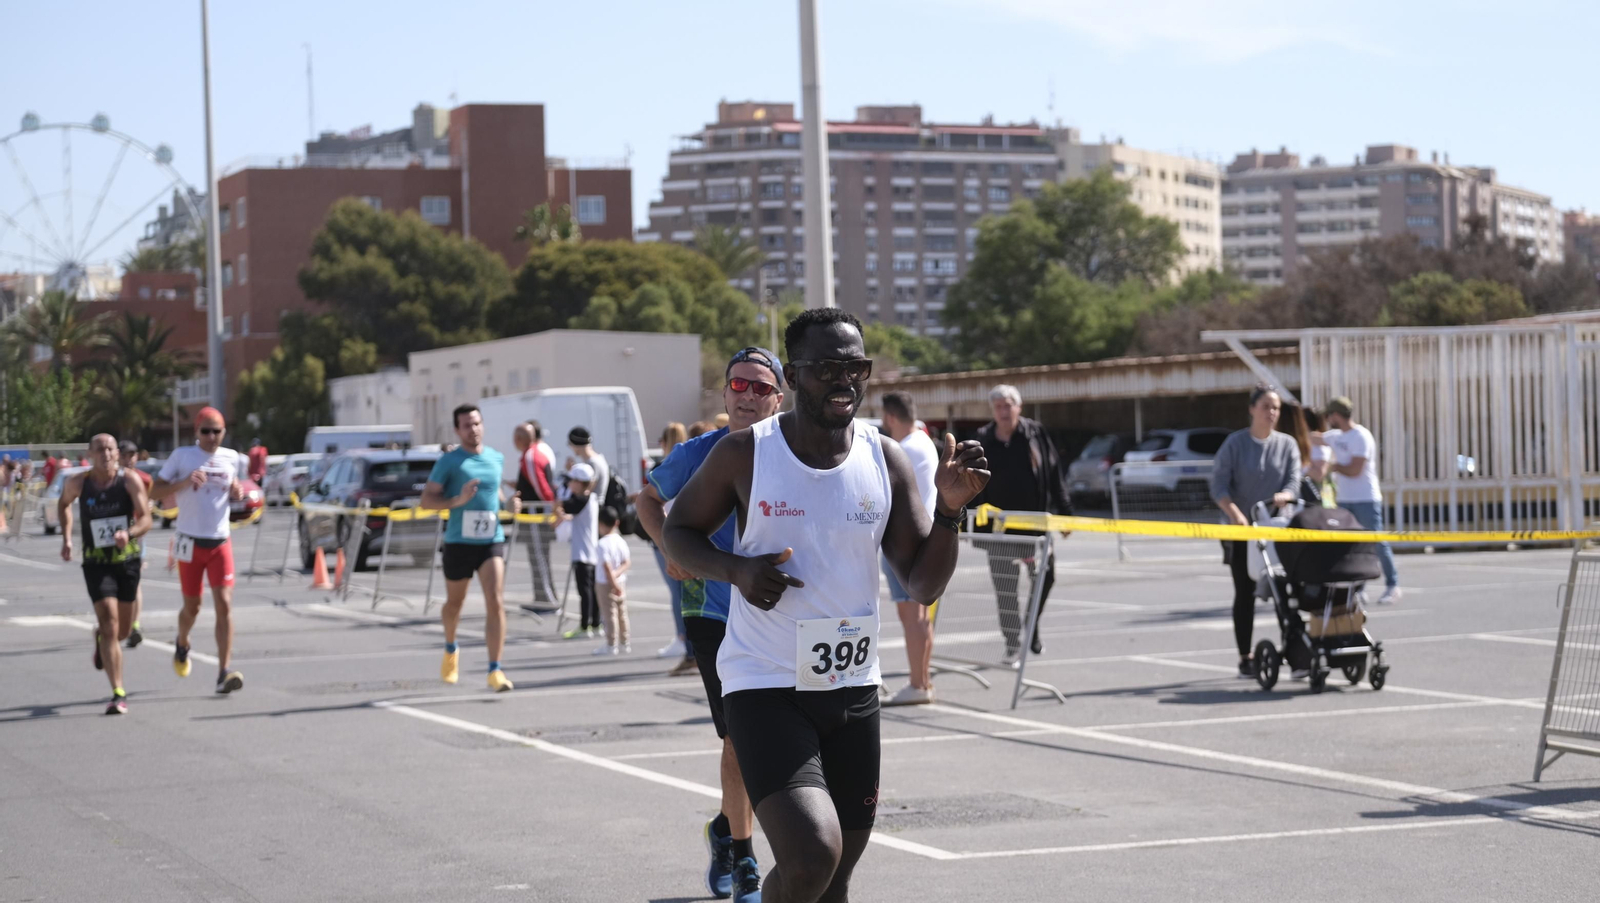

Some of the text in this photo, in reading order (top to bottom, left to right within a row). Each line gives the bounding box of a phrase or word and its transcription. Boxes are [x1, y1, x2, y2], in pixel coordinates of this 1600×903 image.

[774, 500, 787, 508] La
[473, 519, 489, 531] 73
[811, 636, 870, 675] 398
